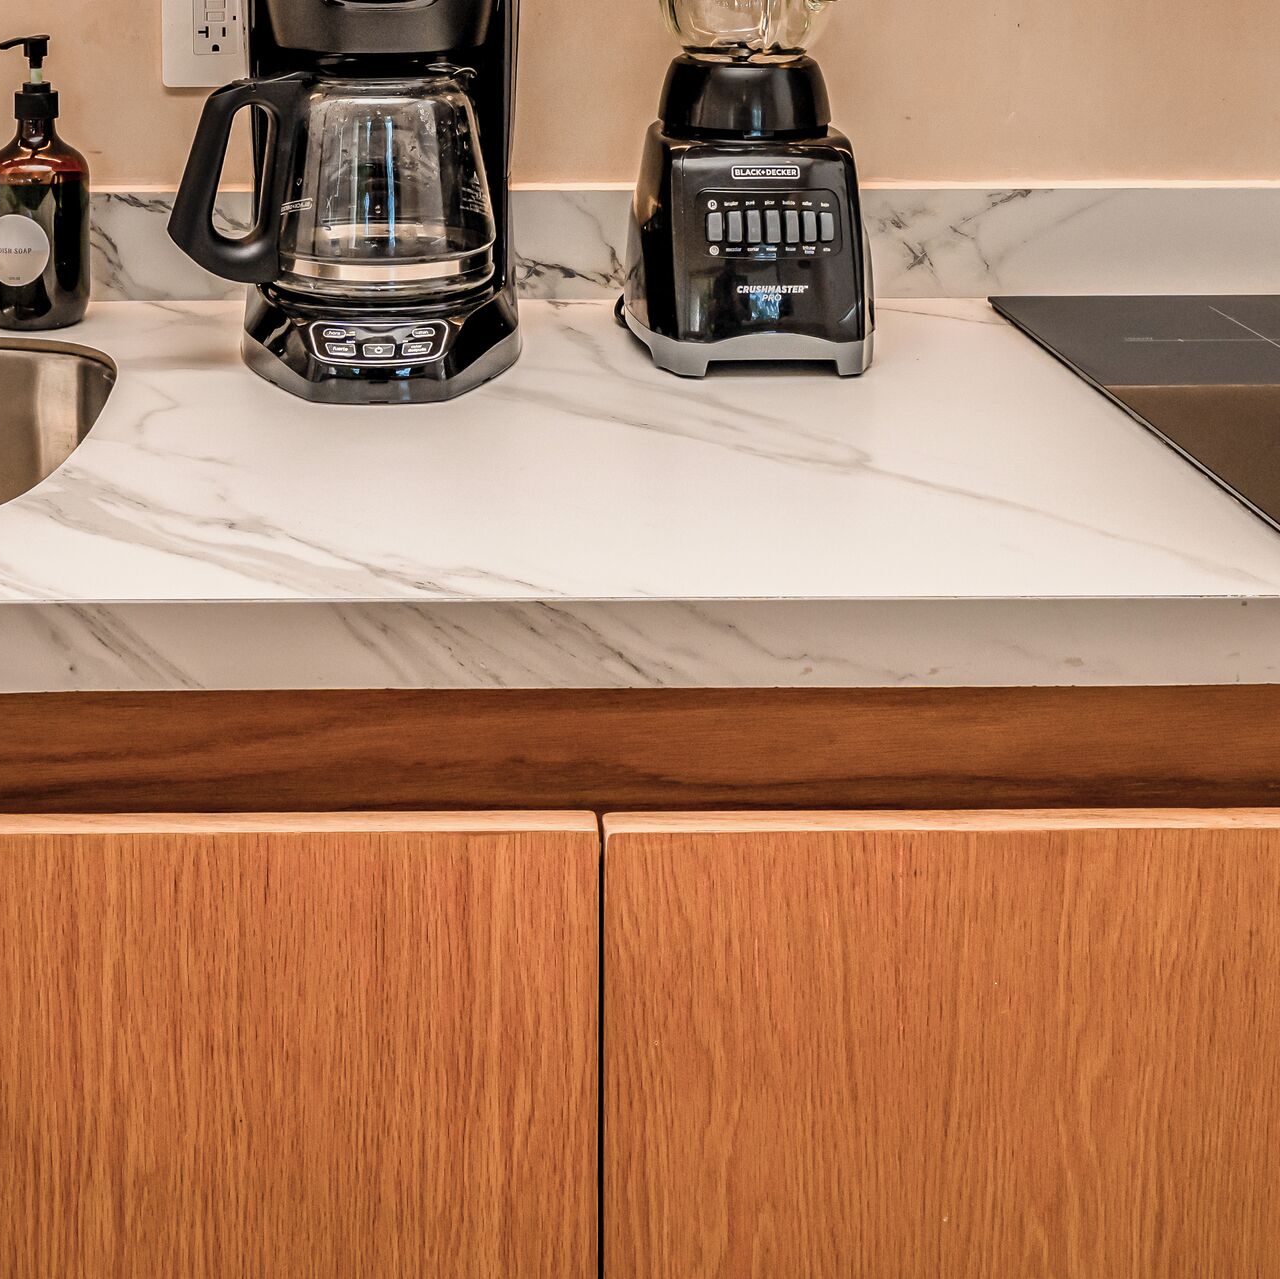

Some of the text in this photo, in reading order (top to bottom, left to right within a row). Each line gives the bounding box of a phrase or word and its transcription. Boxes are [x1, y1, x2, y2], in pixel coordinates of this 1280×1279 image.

[734, 168, 797, 176] BLACK+DECKER
[13, 247, 32, 255] SOAP
[761, 293, 782, 302] PRO
